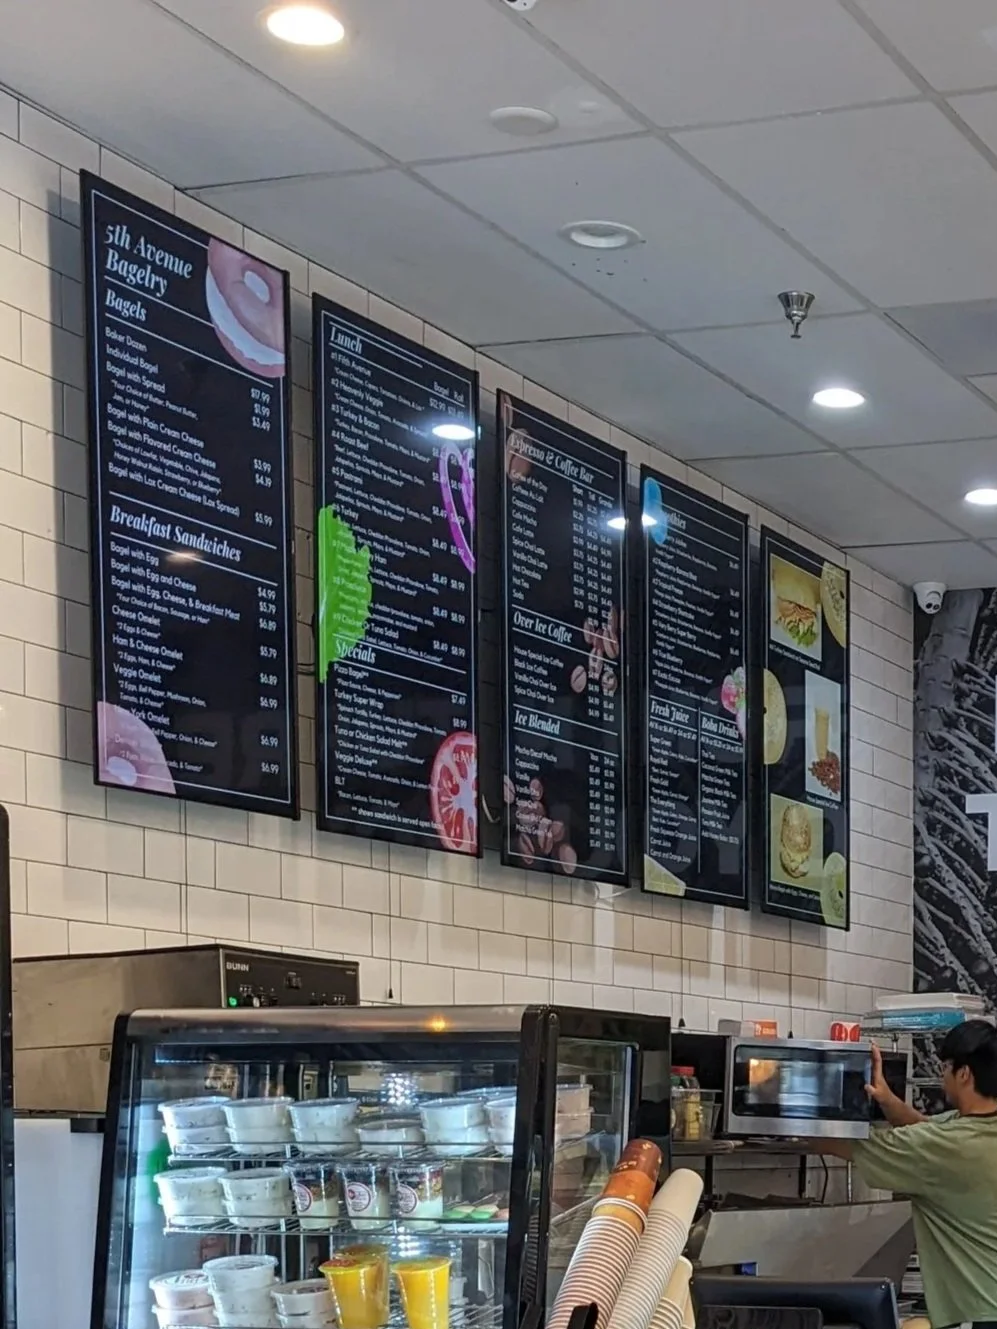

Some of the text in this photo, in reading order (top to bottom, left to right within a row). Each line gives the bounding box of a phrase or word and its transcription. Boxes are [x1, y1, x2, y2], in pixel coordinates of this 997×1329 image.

[105, 225, 192, 278] 5th Avenue
[106, 248, 167, 297] Bagelry
[105, 289, 146, 321] Bagels
[330, 326, 362, 354] Lunch
[105, 326, 270, 403] Baker Dozen $17.99
[106, 344, 270, 417] Individual Bagel $1.99
[106, 361, 270, 431] Bagel with Spread $3.49
[107, 403, 271, 473] Bagel with Plain Cream Cheese $3.99
[107, 420, 127, 436] Bagel
[128, 431, 142, 441] with
[143, 433, 171, 452] Flavored
[172, 445, 193, 460] Cream
[193, 452, 216, 469] Cheese
[546, 451, 554, 465] &
[555, 455, 579, 477] Coffee
[580, 467, 594, 484] Bar
[108, 462, 272, 526] Bagel with Lox Cream Cheese (Lox Spread) $5.99
[110, 505, 241, 562] Breakfast Sandwiches
[110, 541, 276, 600] Bagel with Egg $4.99
[111, 558, 130, 573] Bagel
[131, 567, 145, 576] with
[146, 568, 159, 583] Egg
[160, 575, 173, 585] and
[173, 577, 196, 592] Cheese
[111, 575, 131, 590] Bagel
[132, 583, 146, 593] with
[189, 598, 194, 607] &
[195, 599, 224, 616] Breakfast
[225, 608, 240, 620] Meat
[112, 605, 136, 620] Cheese
[137, 611, 160, 626] Omelet
[514, 611, 572, 643] Over Ice Coffee
[112, 634, 128, 646] Ham
[129, 638, 135, 648] &
[136, 640, 160, 654] Cheese
[160, 646, 183, 660] Omelet
[335, 638, 376, 664] Specials
[113, 663, 277, 708] Veggie Omelet $6.99
[515, 710, 560, 735] Ice Blended
[651, 700, 689, 723] Fresh Juice
[702, 717, 739, 739] Boba Drinks
[226, 961, 249, 972] BUNN
